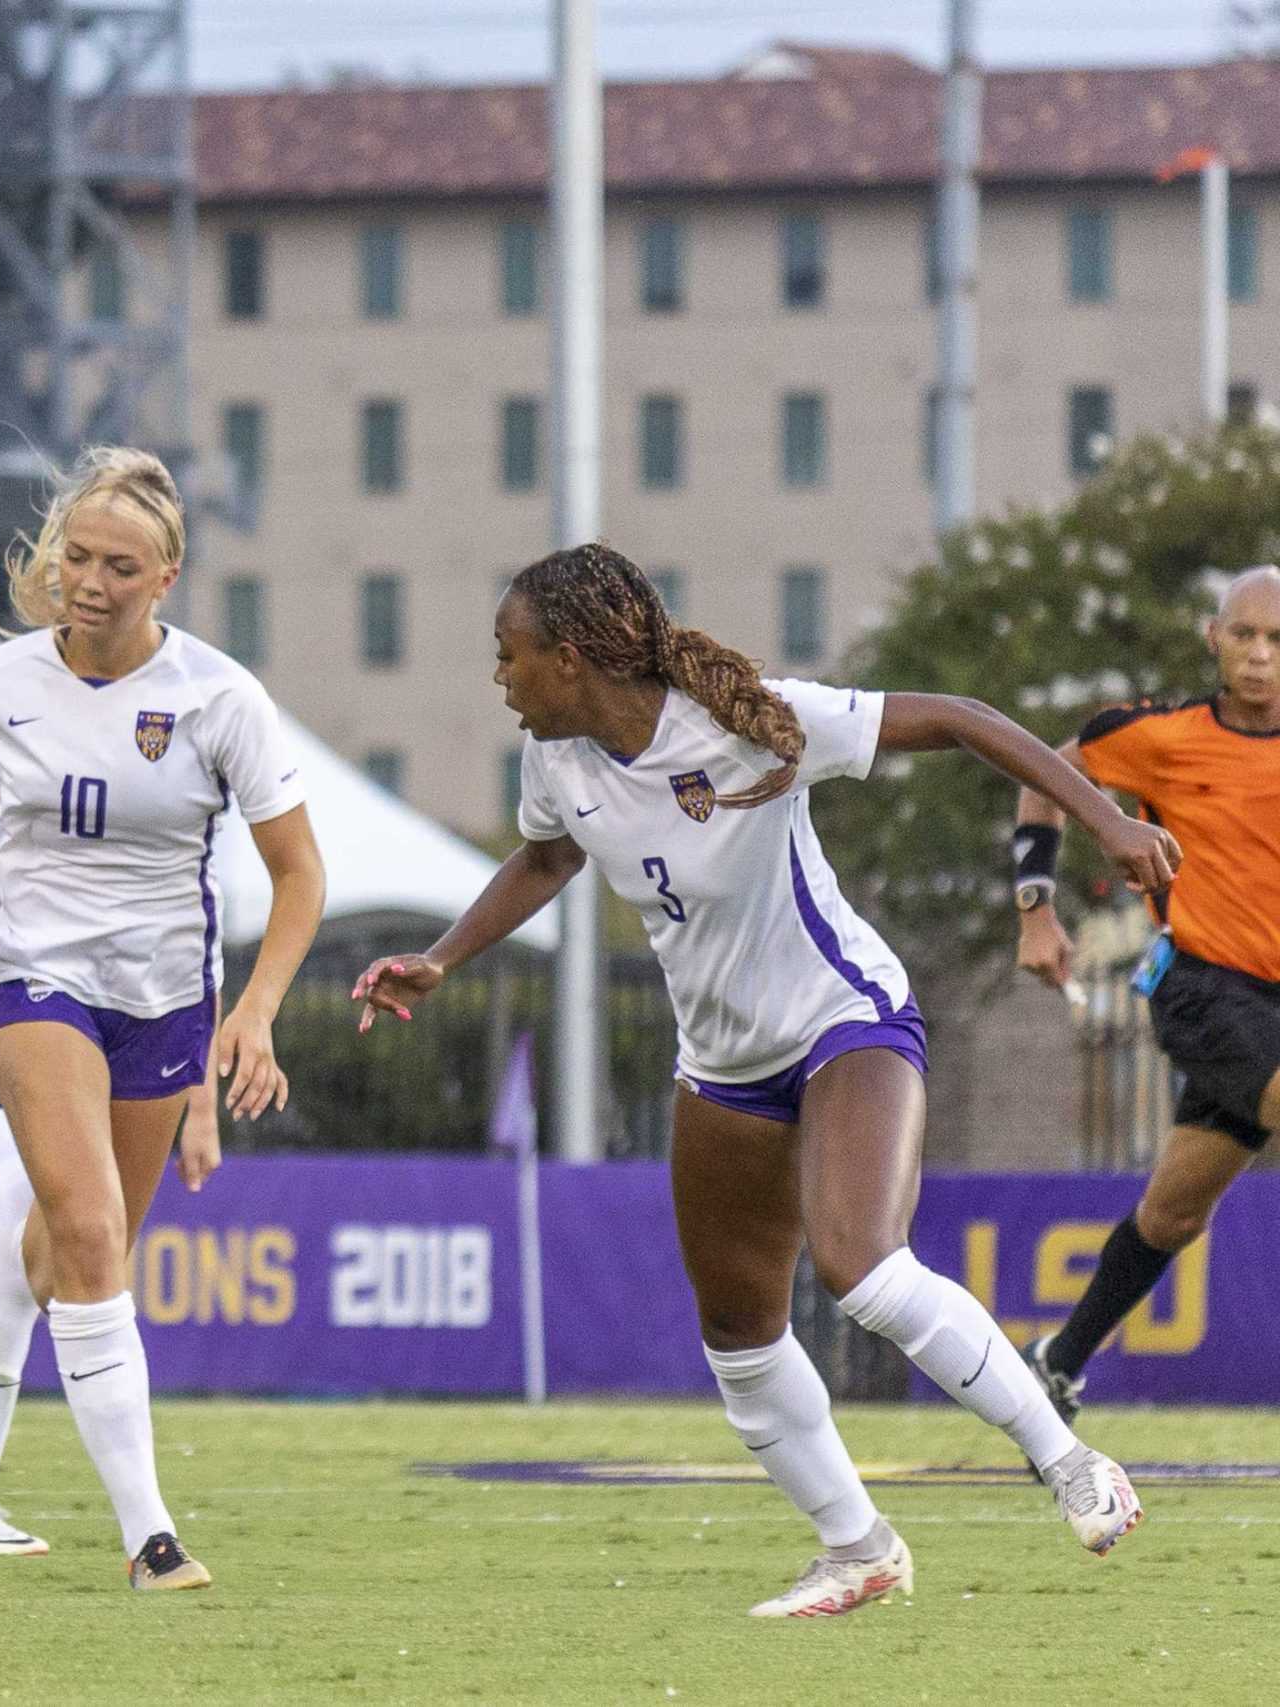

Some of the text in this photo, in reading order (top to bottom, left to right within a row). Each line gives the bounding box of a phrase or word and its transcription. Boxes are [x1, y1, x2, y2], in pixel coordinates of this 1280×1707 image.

[60, 773, 107, 839] 10
[642, 856, 687, 923] 3
[330, 1223, 493, 1329] 2018
